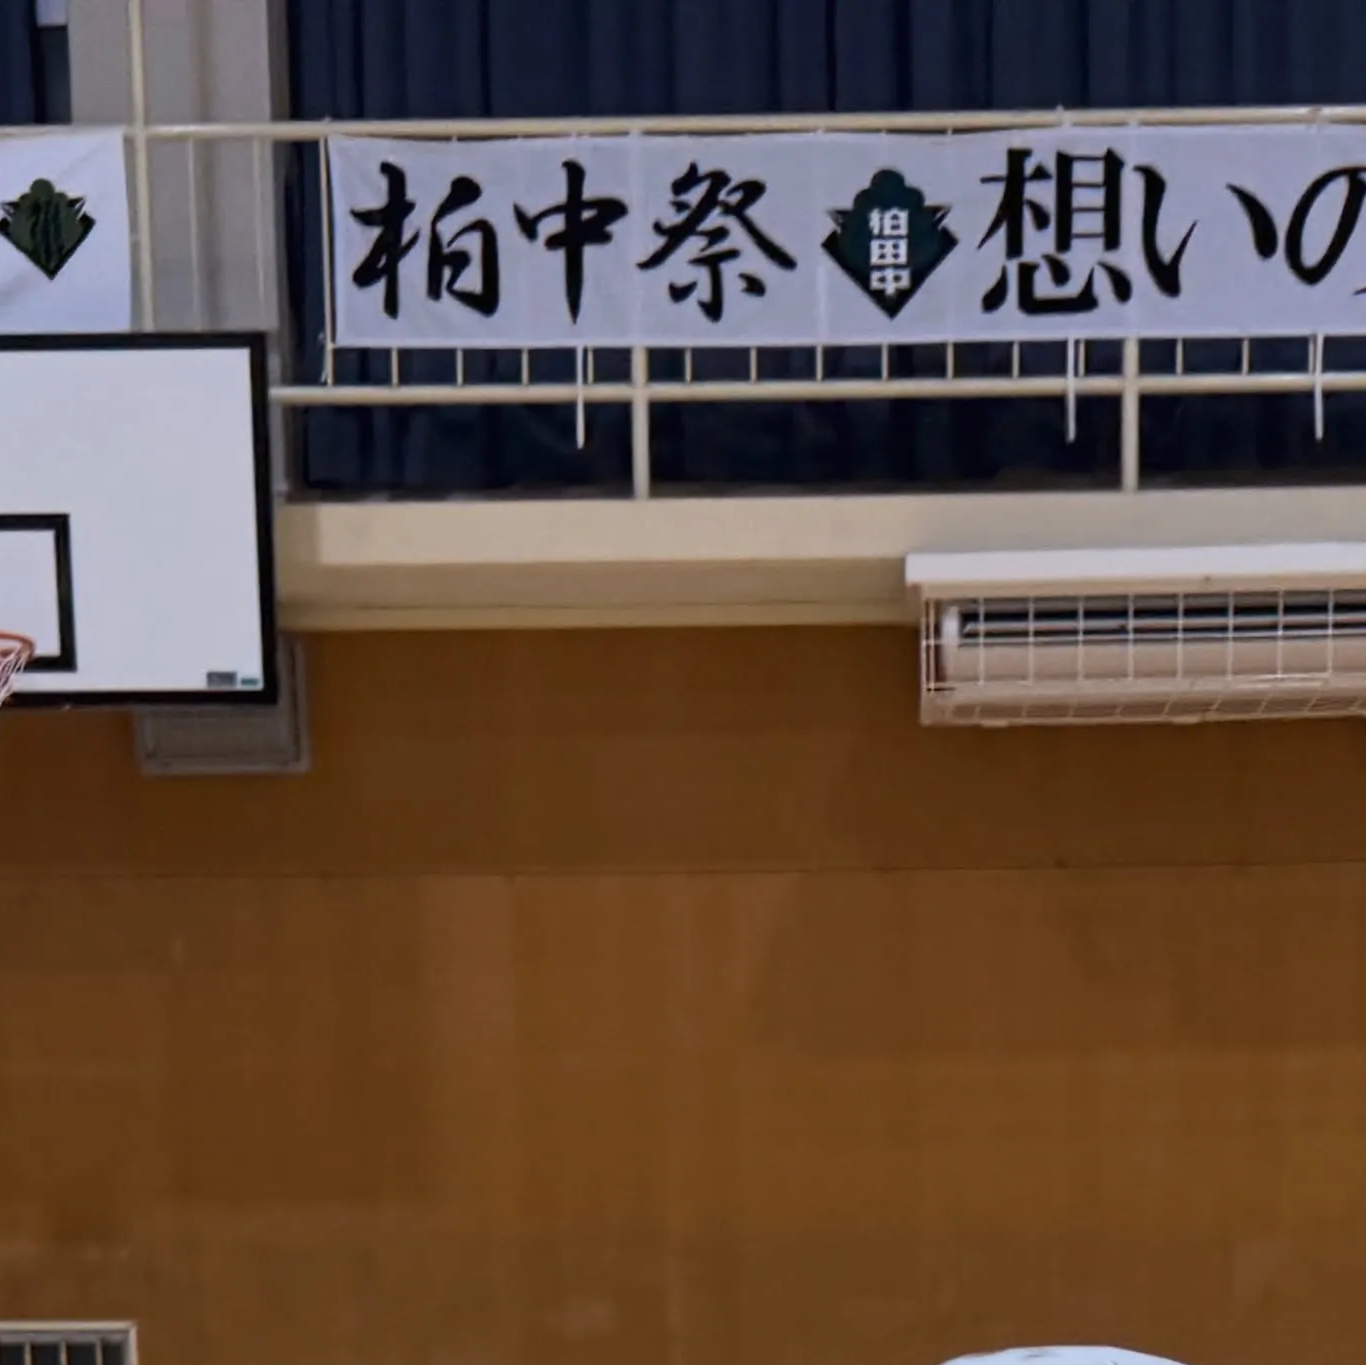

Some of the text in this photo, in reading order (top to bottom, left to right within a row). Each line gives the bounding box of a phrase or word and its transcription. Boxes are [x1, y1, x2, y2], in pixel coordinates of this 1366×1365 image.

[349, 160, 798, 325] 柏中祭
[868, 207, 912, 296] 柏田中
